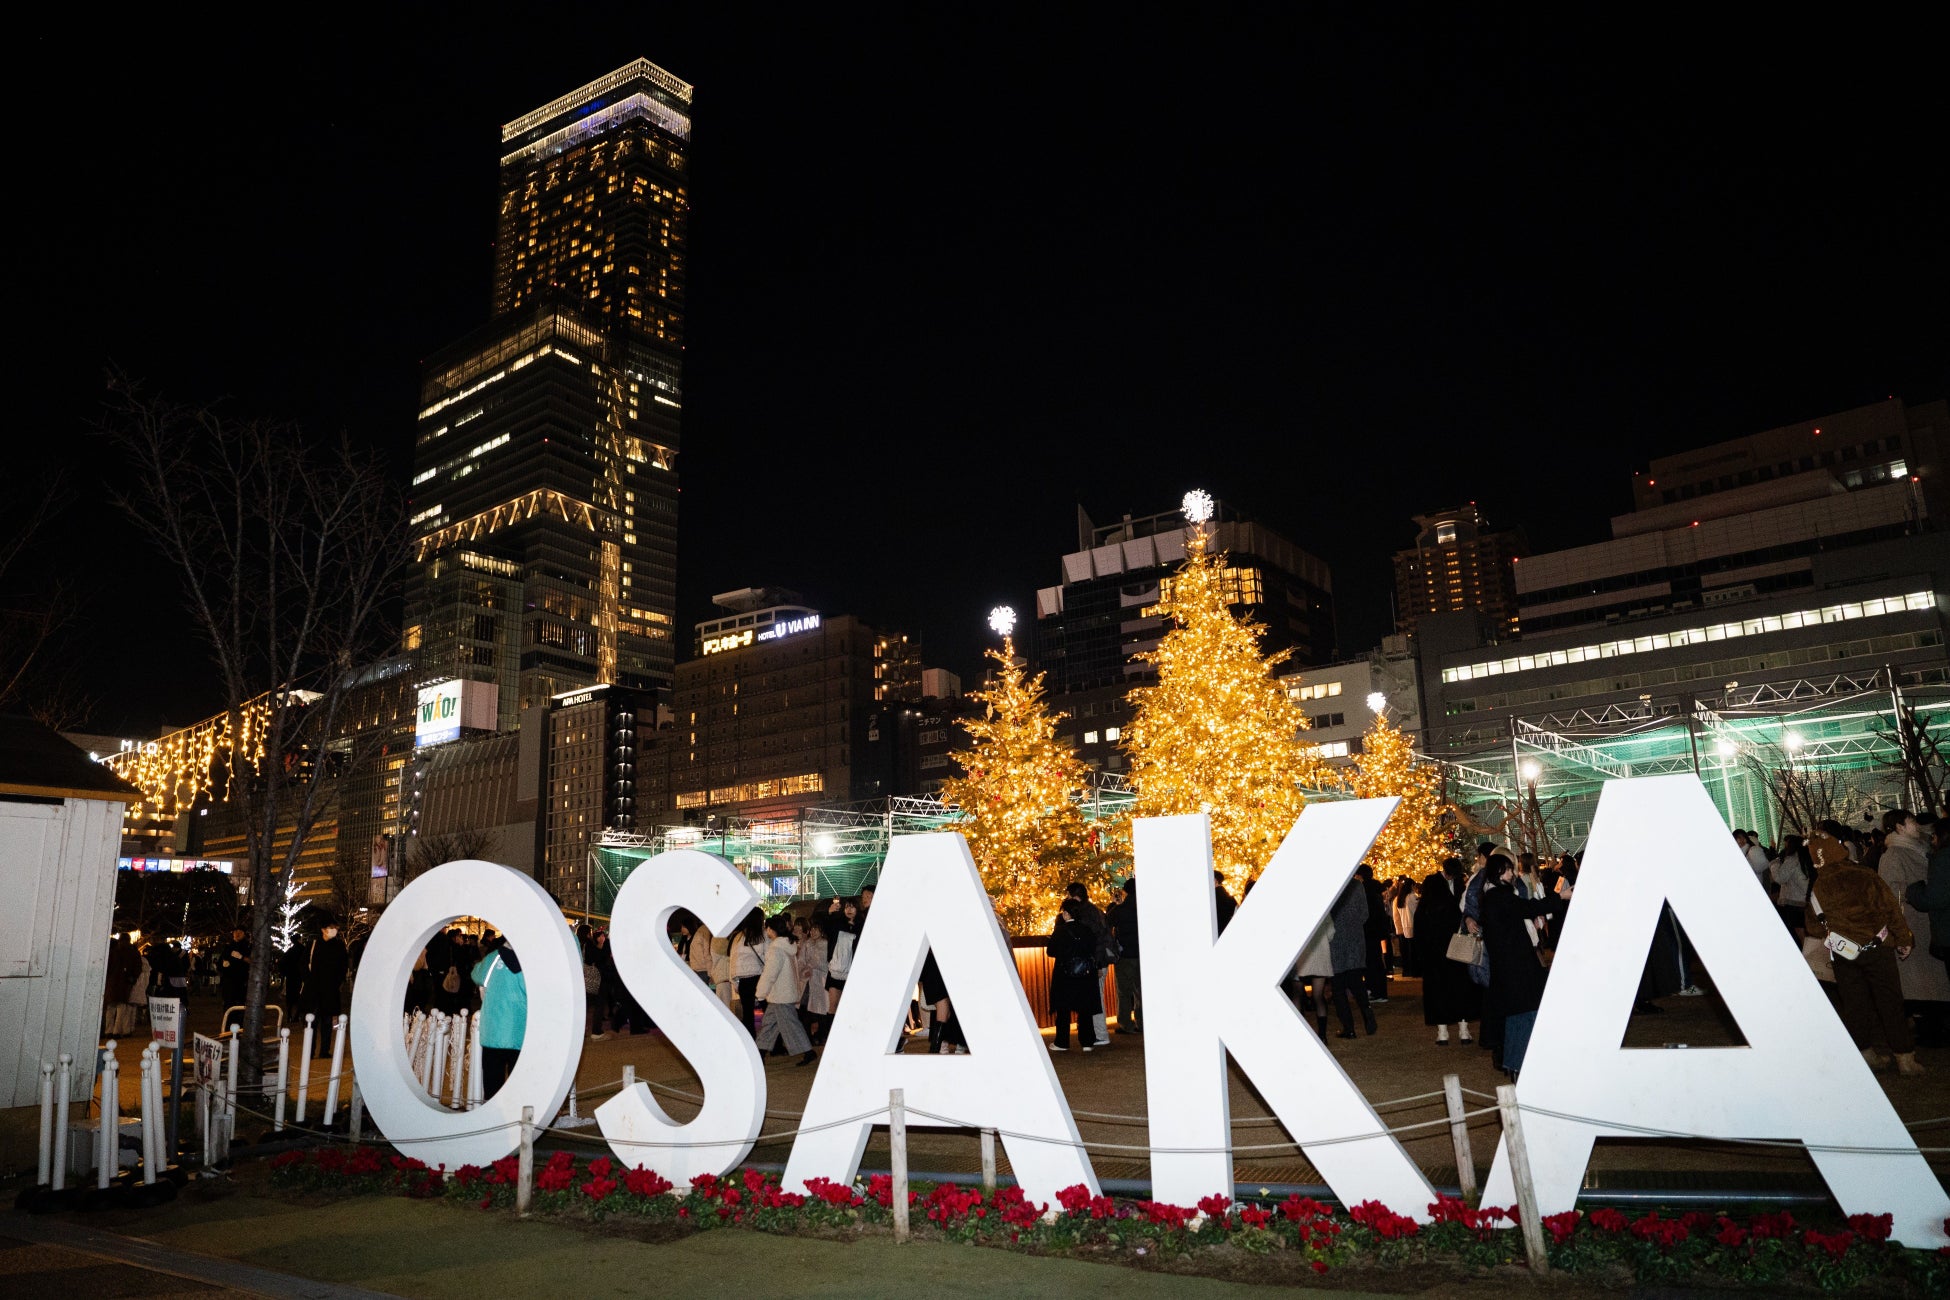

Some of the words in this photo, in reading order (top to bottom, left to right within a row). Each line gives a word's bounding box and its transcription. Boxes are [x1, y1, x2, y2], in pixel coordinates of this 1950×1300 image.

[758, 630, 776, 641] HOTEL
[788, 620, 803, 633] VIA
[803, 615, 819, 630] INN
[562, 697, 573, 707] APA
[574, 692, 592, 704] HOTEL
[121, 739, 158, 755] MIO
[350, 774, 1950, 1248] OSAKA
